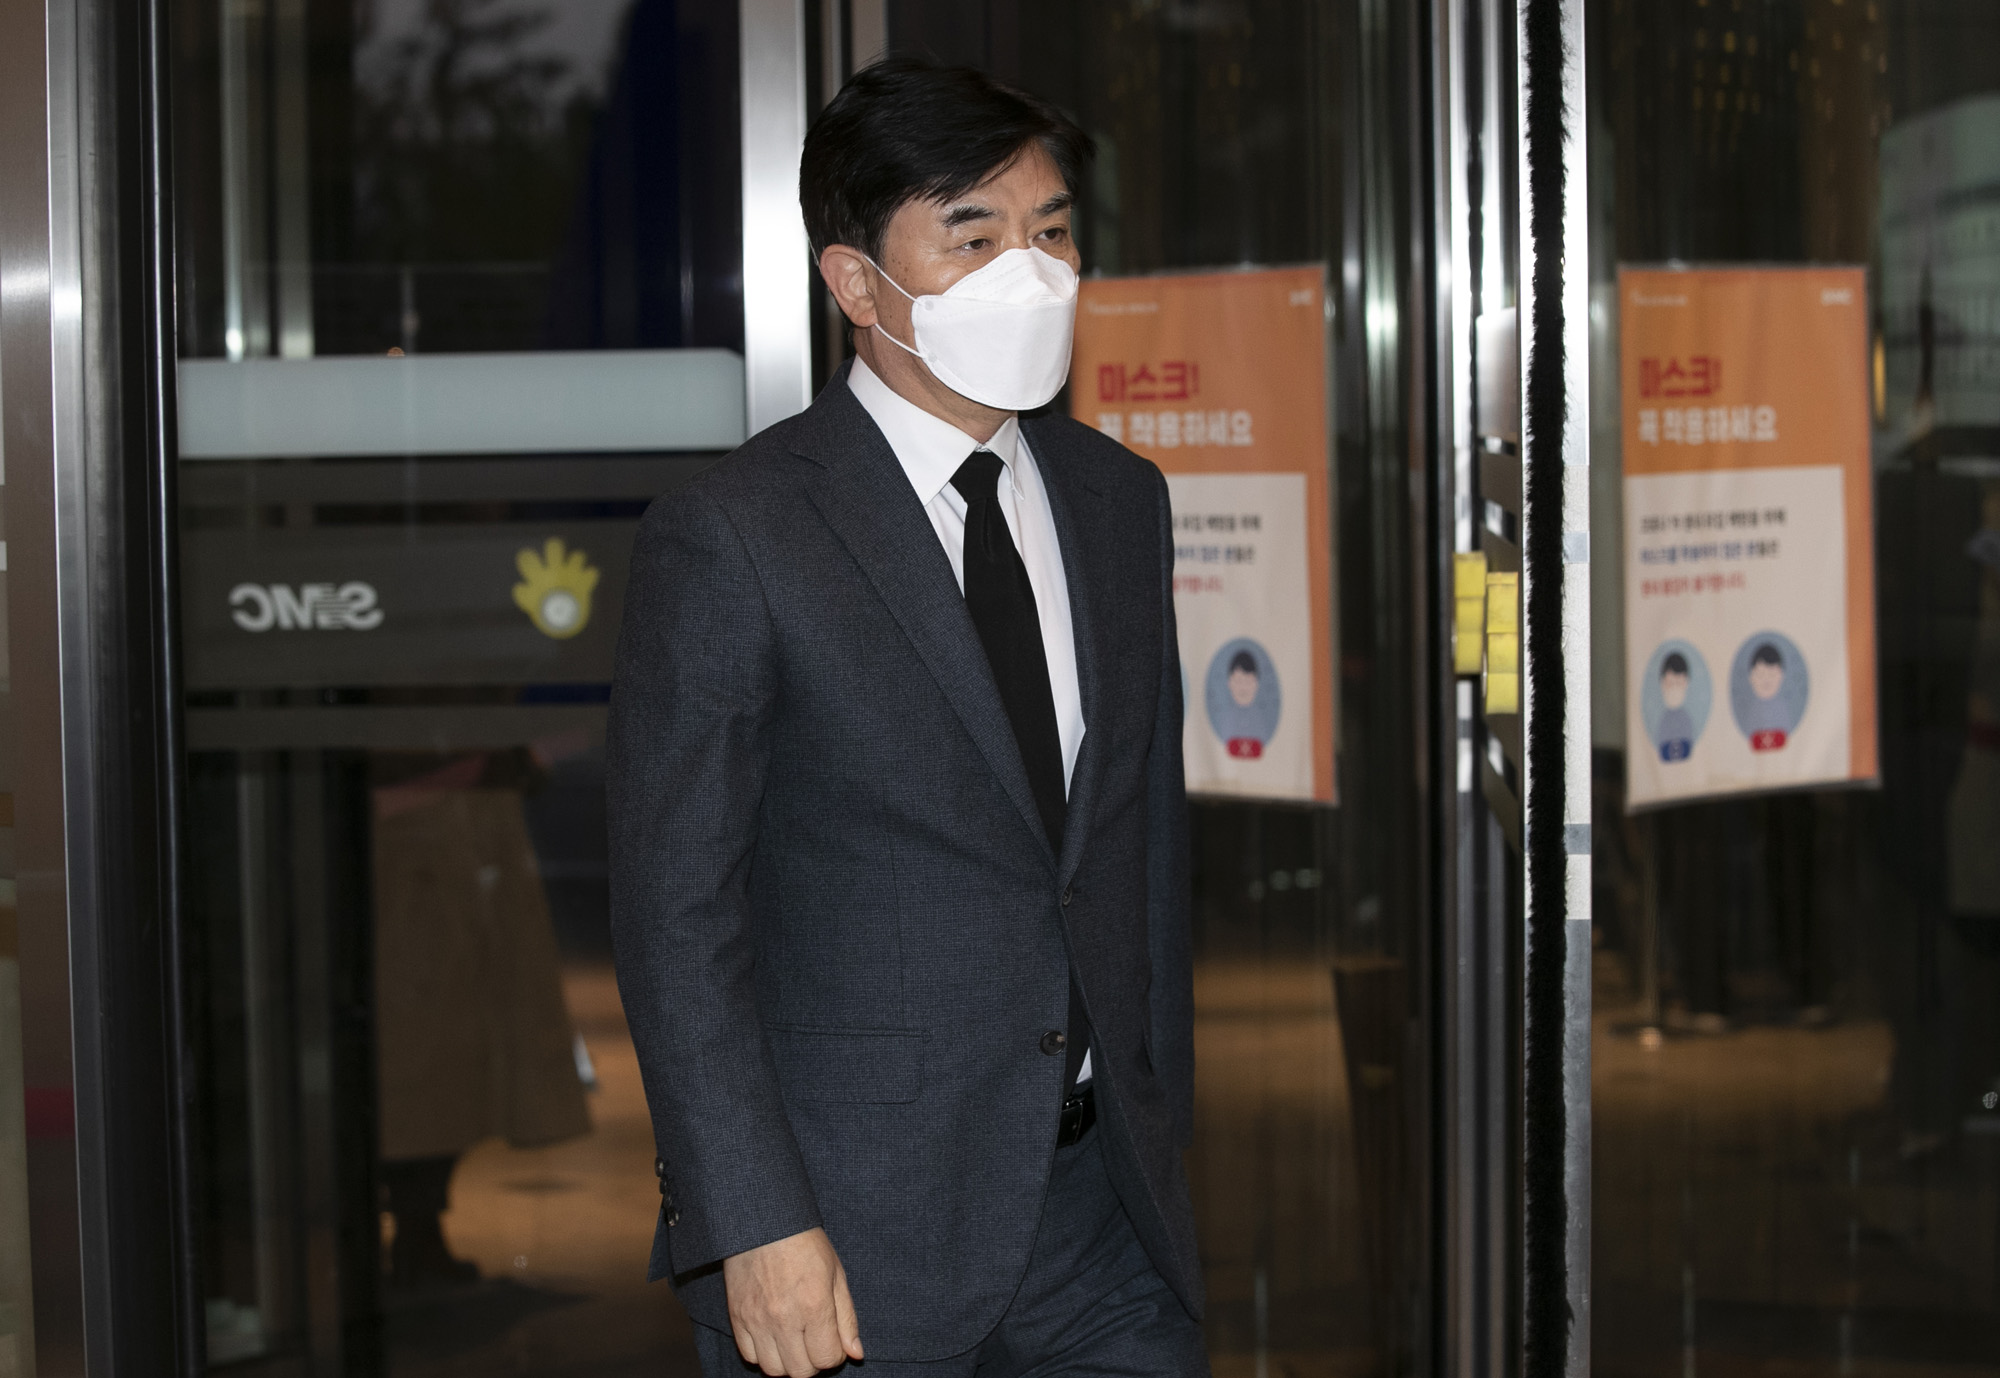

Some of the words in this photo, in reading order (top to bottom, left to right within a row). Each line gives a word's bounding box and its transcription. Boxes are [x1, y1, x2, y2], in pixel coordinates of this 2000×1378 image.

[1097, 361, 1200, 402] 마스크!
[1639, 357, 1722, 398] 마스크!
[1129, 408, 1253, 448] 착용하세요
[1662, 404, 1778, 445] 착용하세요
